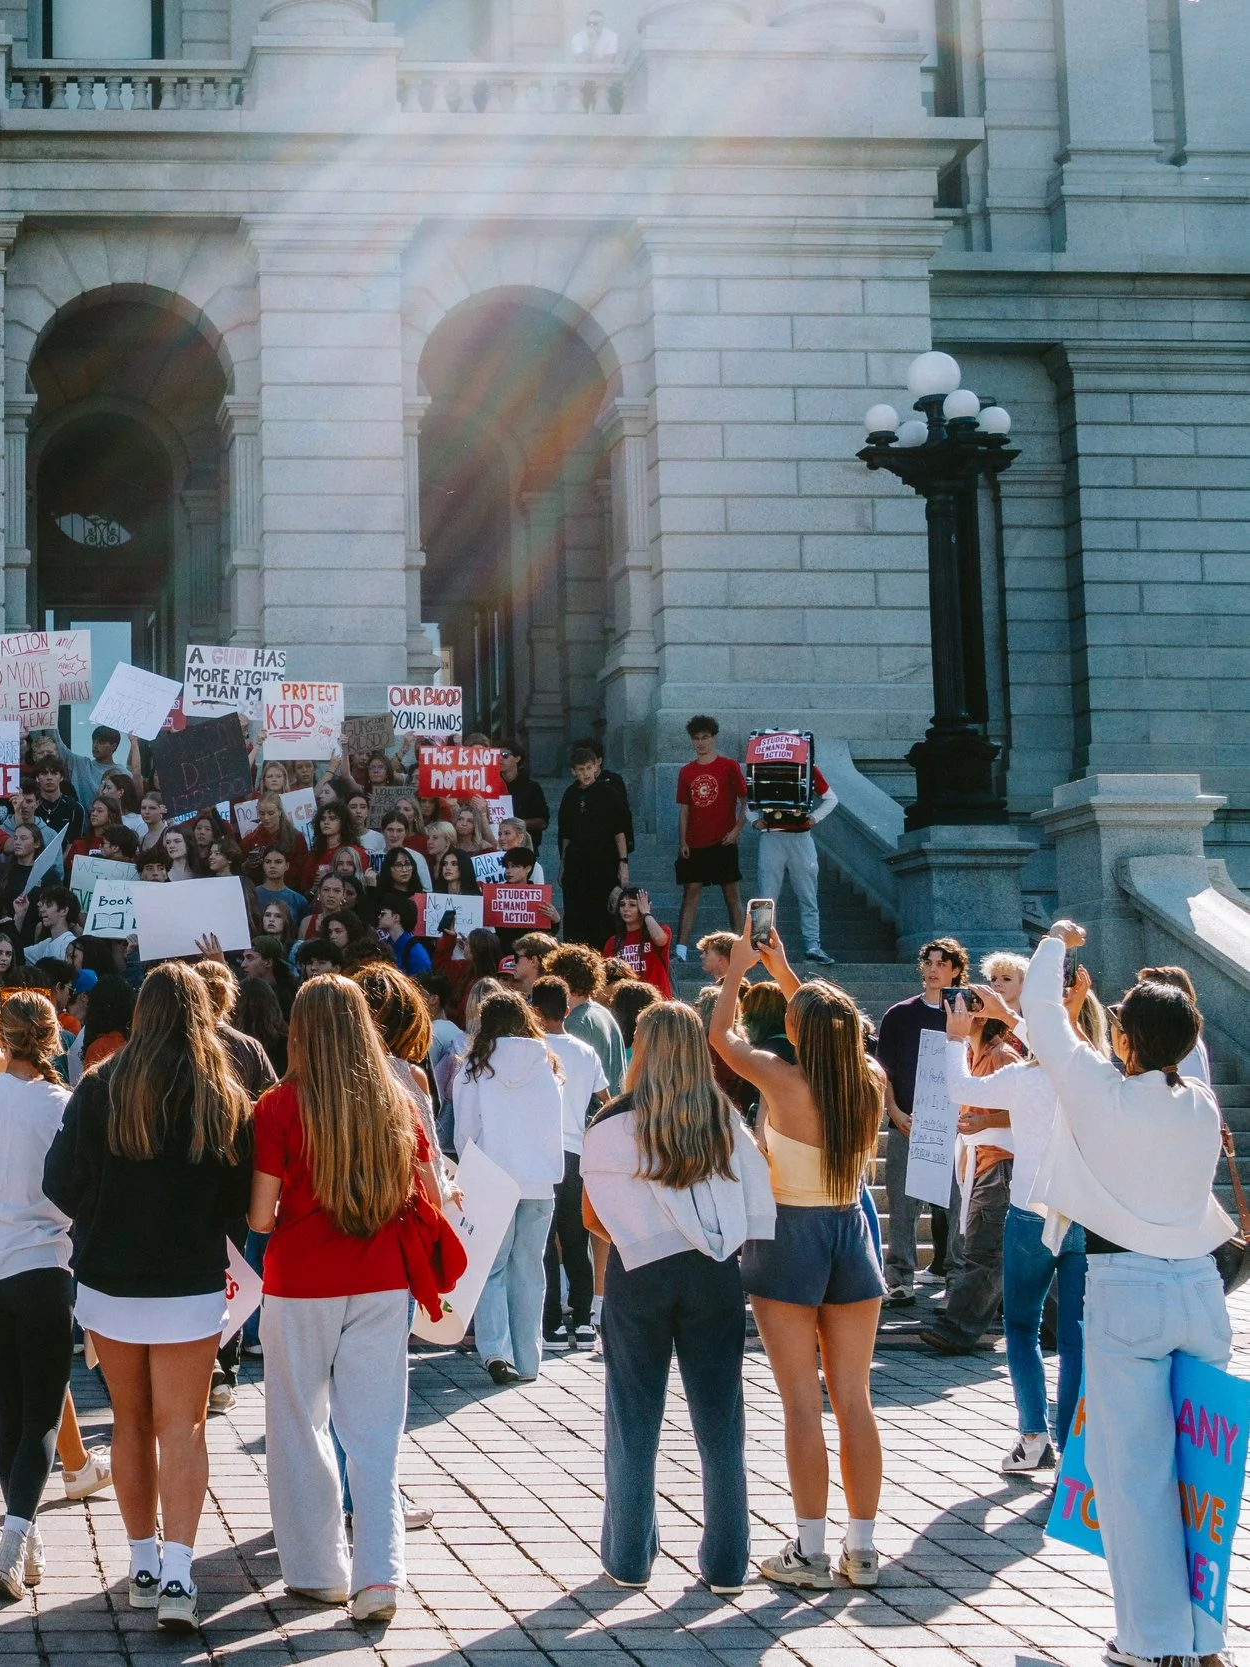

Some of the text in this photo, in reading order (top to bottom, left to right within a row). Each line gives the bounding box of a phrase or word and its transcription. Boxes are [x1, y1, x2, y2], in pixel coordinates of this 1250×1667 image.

[1, 633, 77, 655] ACTION and
[189, 648, 286, 667] A GUN HAS
[7, 662, 48, 689] MORE
[187, 667, 230, 684] MORE
[235, 670, 285, 686] RIGHTS
[19, 692, 50, 708] END
[194, 684, 262, 701] THAN M
[282, 683, 339, 701] PROTECT
[389, 687, 420, 706] OUR
[266, 704, 315, 729] KIDS
[319, 705, 335, 713] NOT
[390, 709, 461, 731] YOUR HANDS
[756, 743, 786, 754] DEMAND
[761, 736, 800, 746] STUDENTS
[421, 748, 454, 765] This
[473, 749, 501, 765] NOT
[764, 751, 792, 759] ACTION
[77, 858, 103, 878] WE
[485, 873, 506, 883] PLA
[98, 896, 133, 907] Book
[428, 896, 440, 910] No
[497, 890, 541, 900] STUDENTS
[493, 901, 526, 911] DEMAND
[456, 914, 473, 925] End
[504, 913, 534, 923] ACTION
[1174, 1398, 1239, 1466] ANY
[1061, 1475, 1100, 1531] TO
[1180, 1481, 1226, 1545] AVE
[1191, 1552, 1220, 1612] E?
